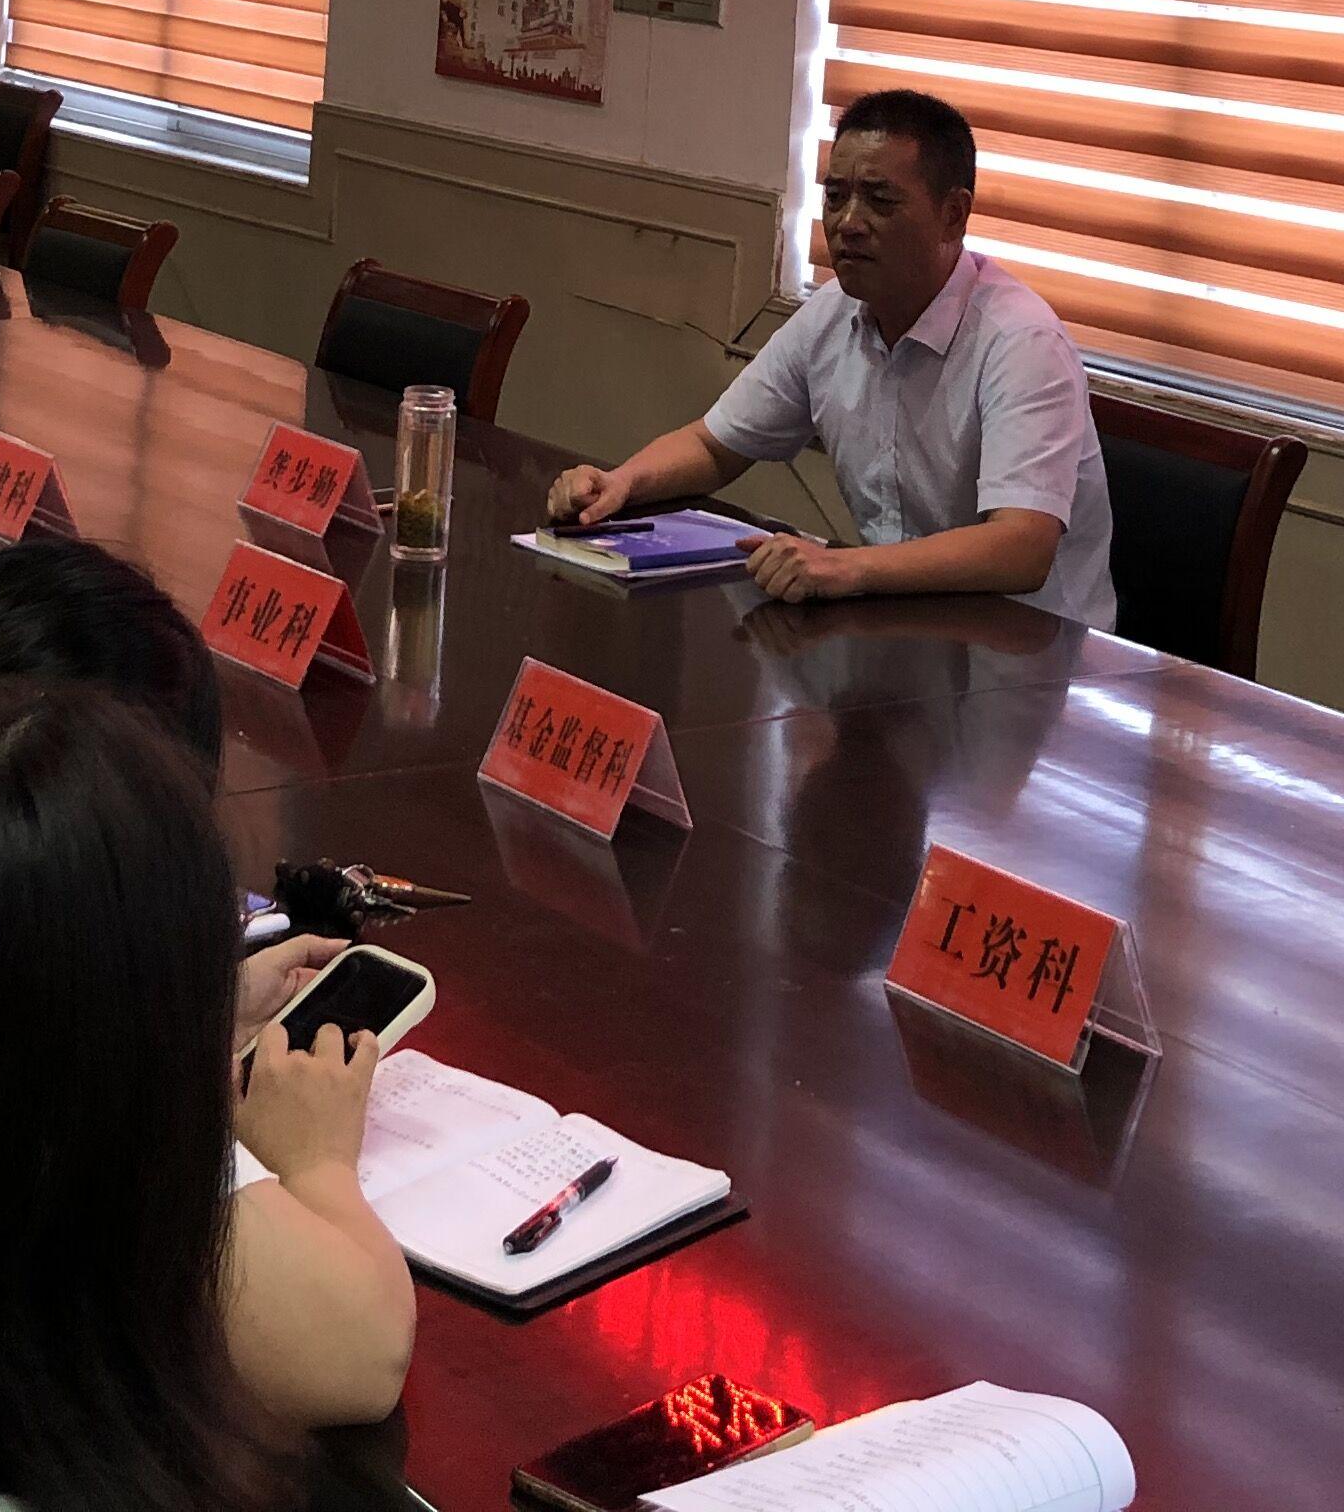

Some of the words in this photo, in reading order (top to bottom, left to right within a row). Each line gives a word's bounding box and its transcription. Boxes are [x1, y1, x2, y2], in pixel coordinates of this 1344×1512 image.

[223, 575, 319, 657] 事业科
[503, 696, 635, 798] 基金监督科
[924, 895, 1081, 1013] 工资科
